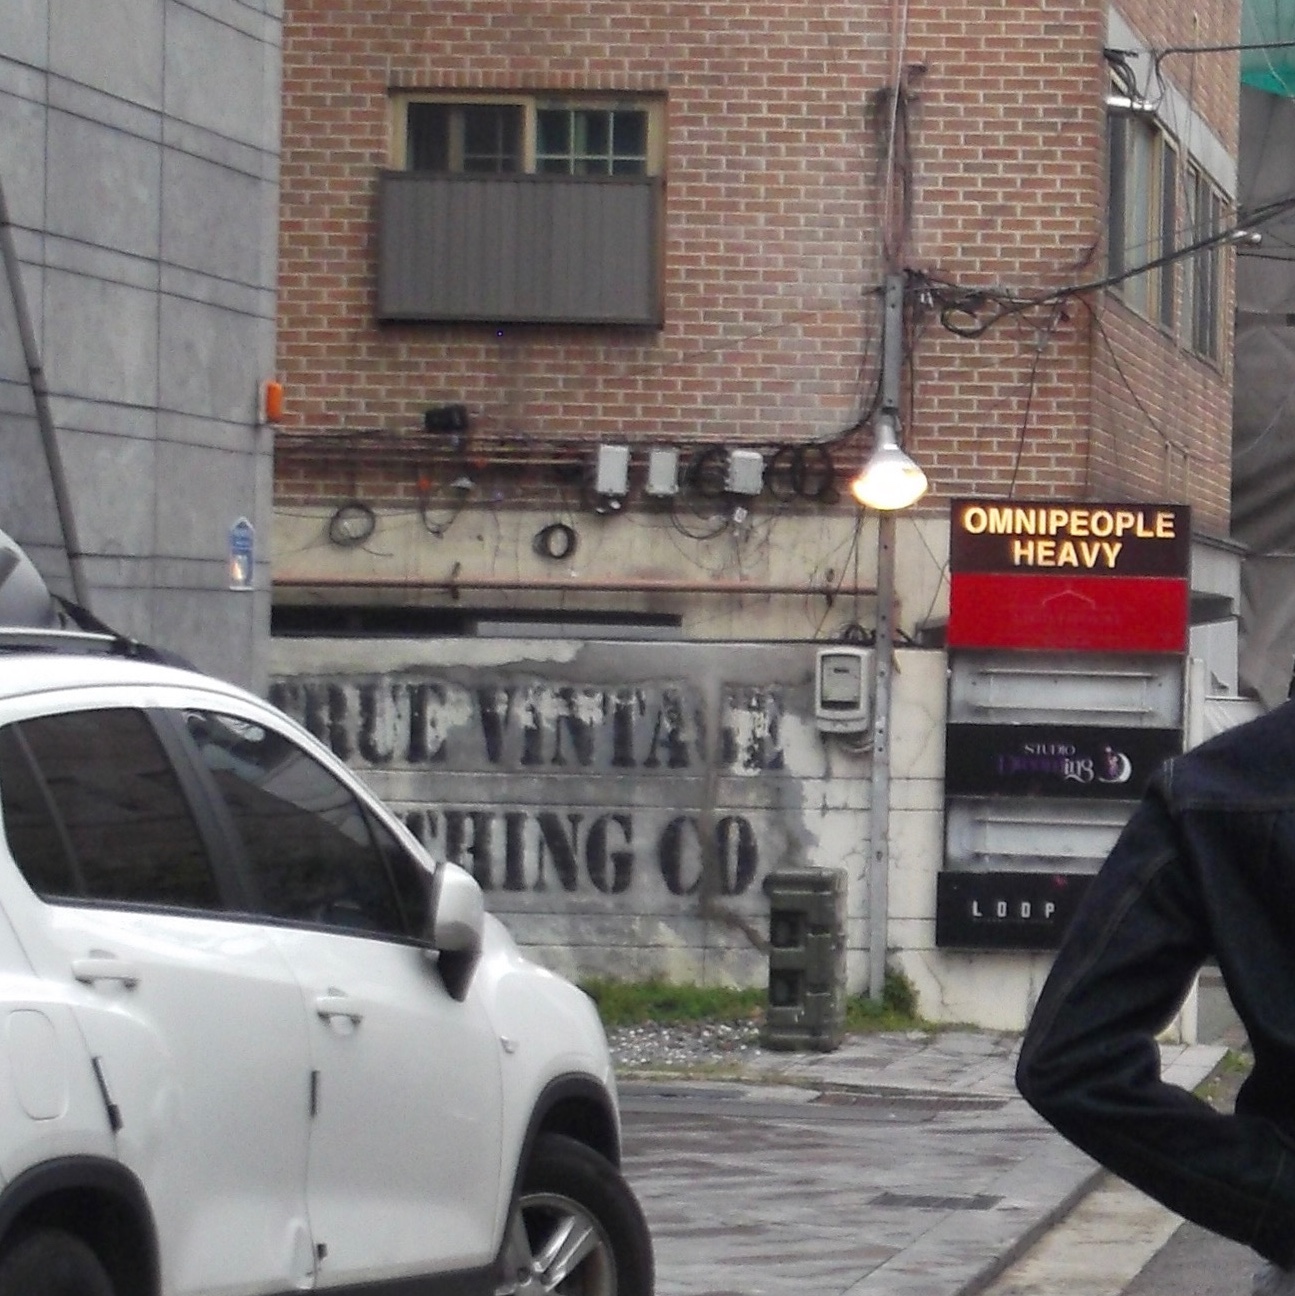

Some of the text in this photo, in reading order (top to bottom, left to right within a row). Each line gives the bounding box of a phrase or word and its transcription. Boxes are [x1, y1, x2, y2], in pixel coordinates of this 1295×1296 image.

[964, 507, 1176, 539] OMNIPEOPLE
[1013, 540, 1122, 569] HEAVY
[1024, 744, 1076, 756] STUDIO
[658, 814, 759, 895] CO
[972, 900, 1056, 919] LOOP
